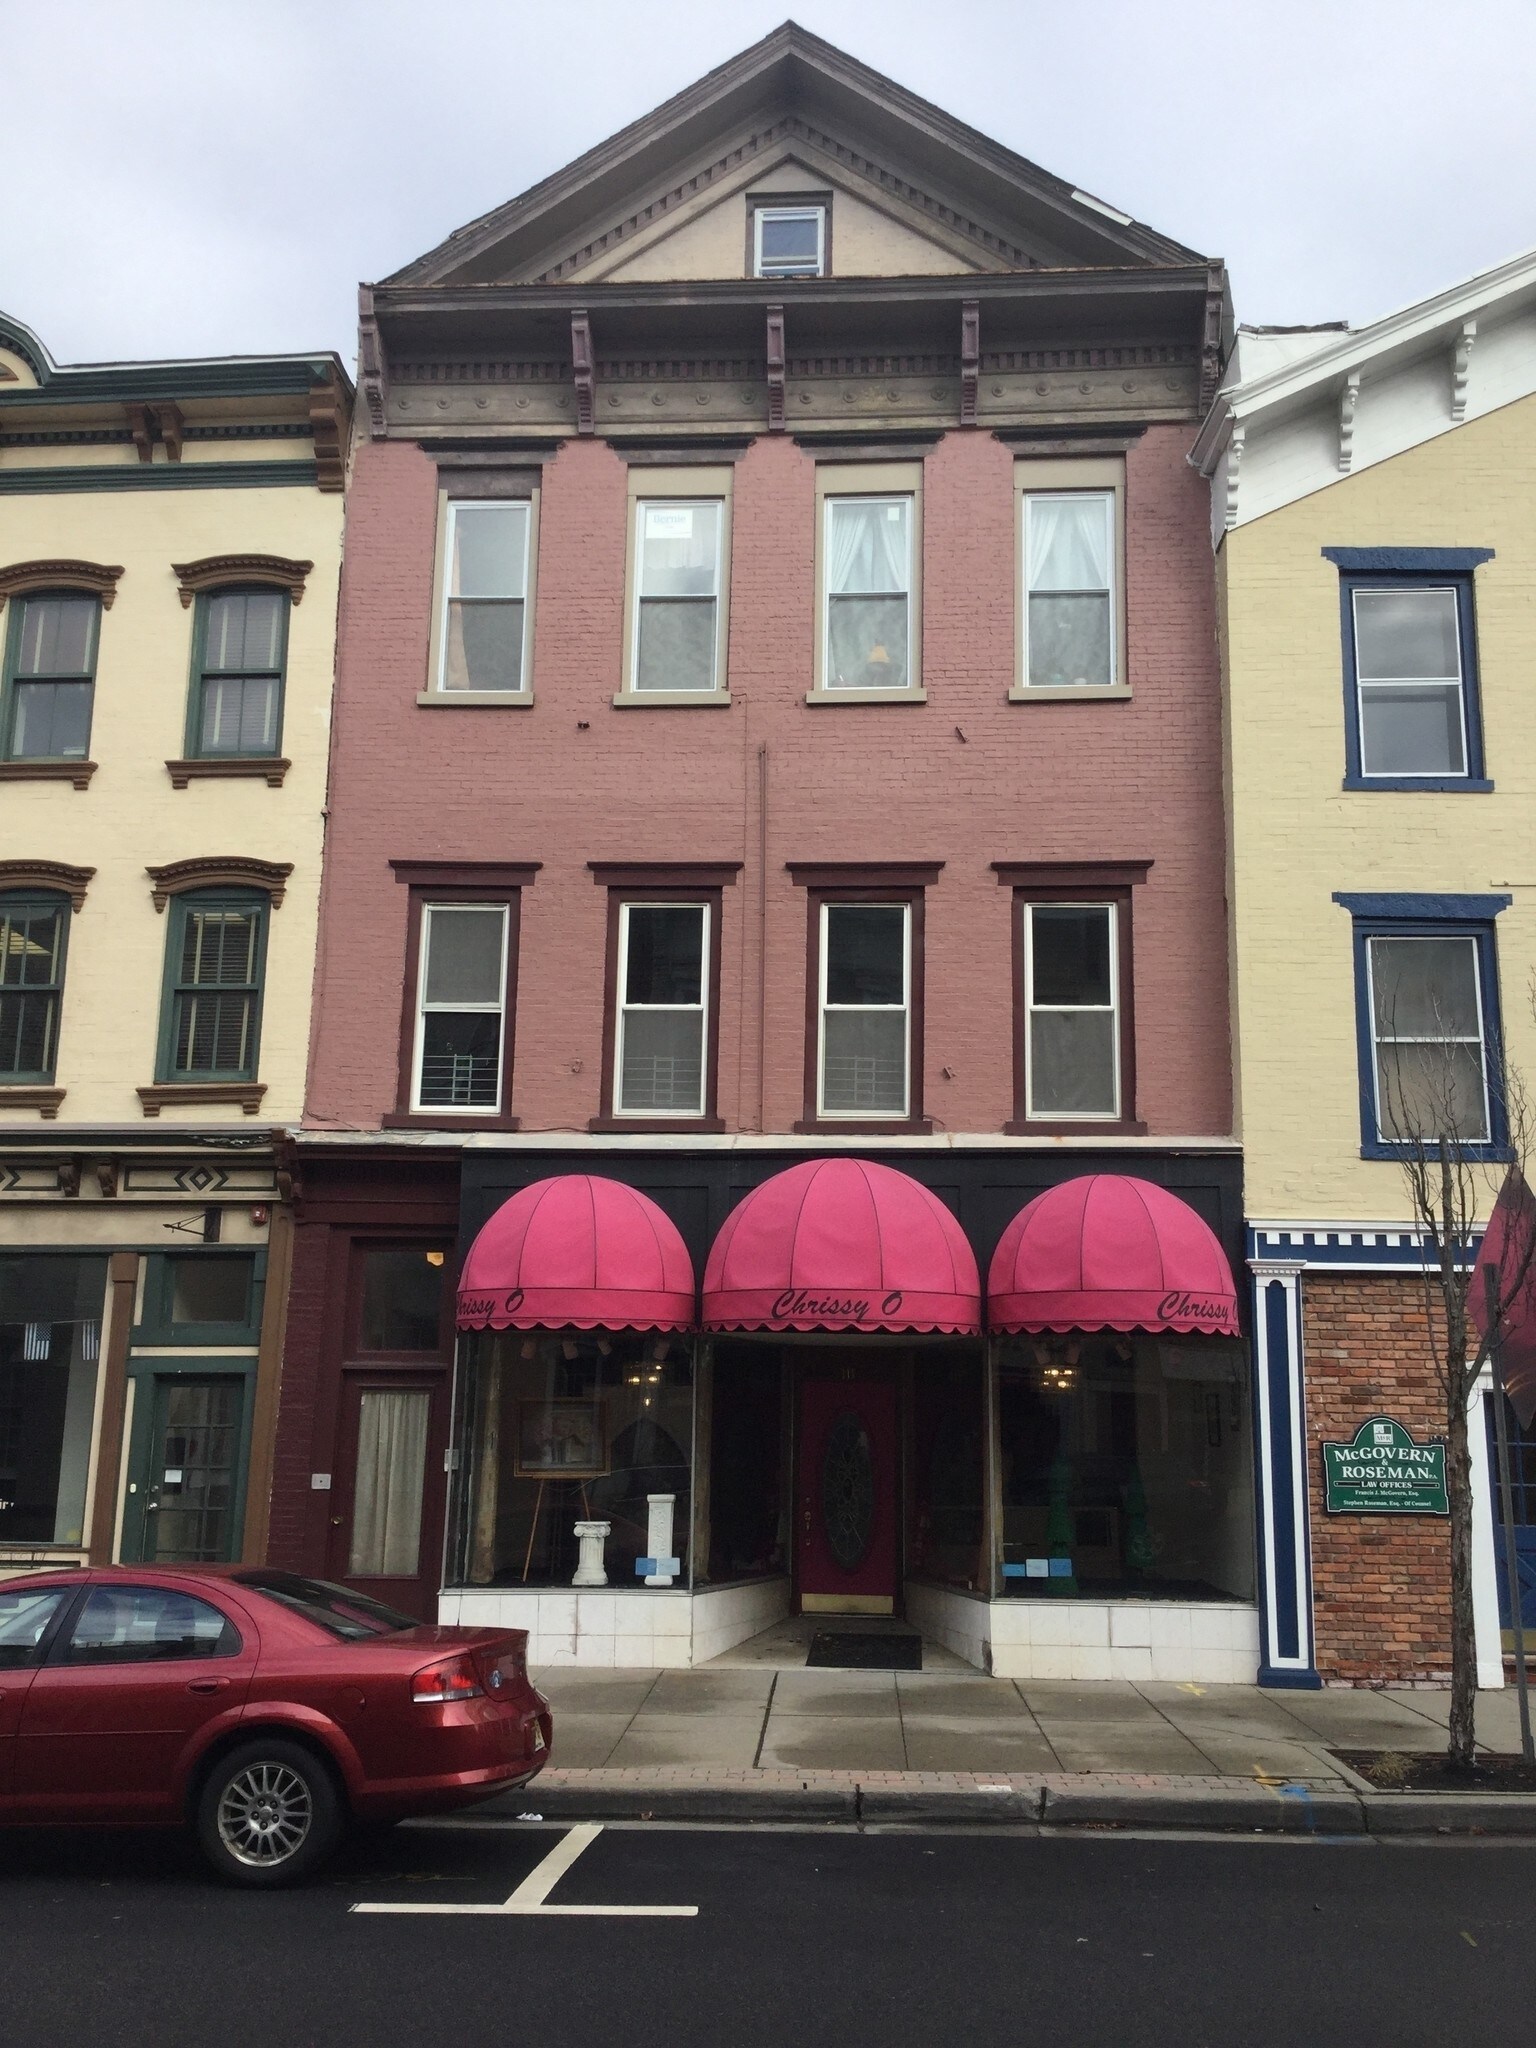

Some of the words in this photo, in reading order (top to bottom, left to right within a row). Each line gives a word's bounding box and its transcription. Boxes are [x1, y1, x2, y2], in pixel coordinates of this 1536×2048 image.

[653, 514, 686, 523] Bernie
[505, 1288, 525, 1313] O
[771, 1289, 870, 1322] Chrissy
[881, 1291, 903, 1316] O
[1157, 1292, 1228, 1327] Chrissy
[1334, 1447, 1436, 1464] McGOVERN
[1381, 1458, 1388, 1466] &
[1342, 1466, 1429, 1479] ROSEMAN
[1361, 1480, 1377, 1488] LAW
[1379, 1481, 1413, 1489] OFFICES
